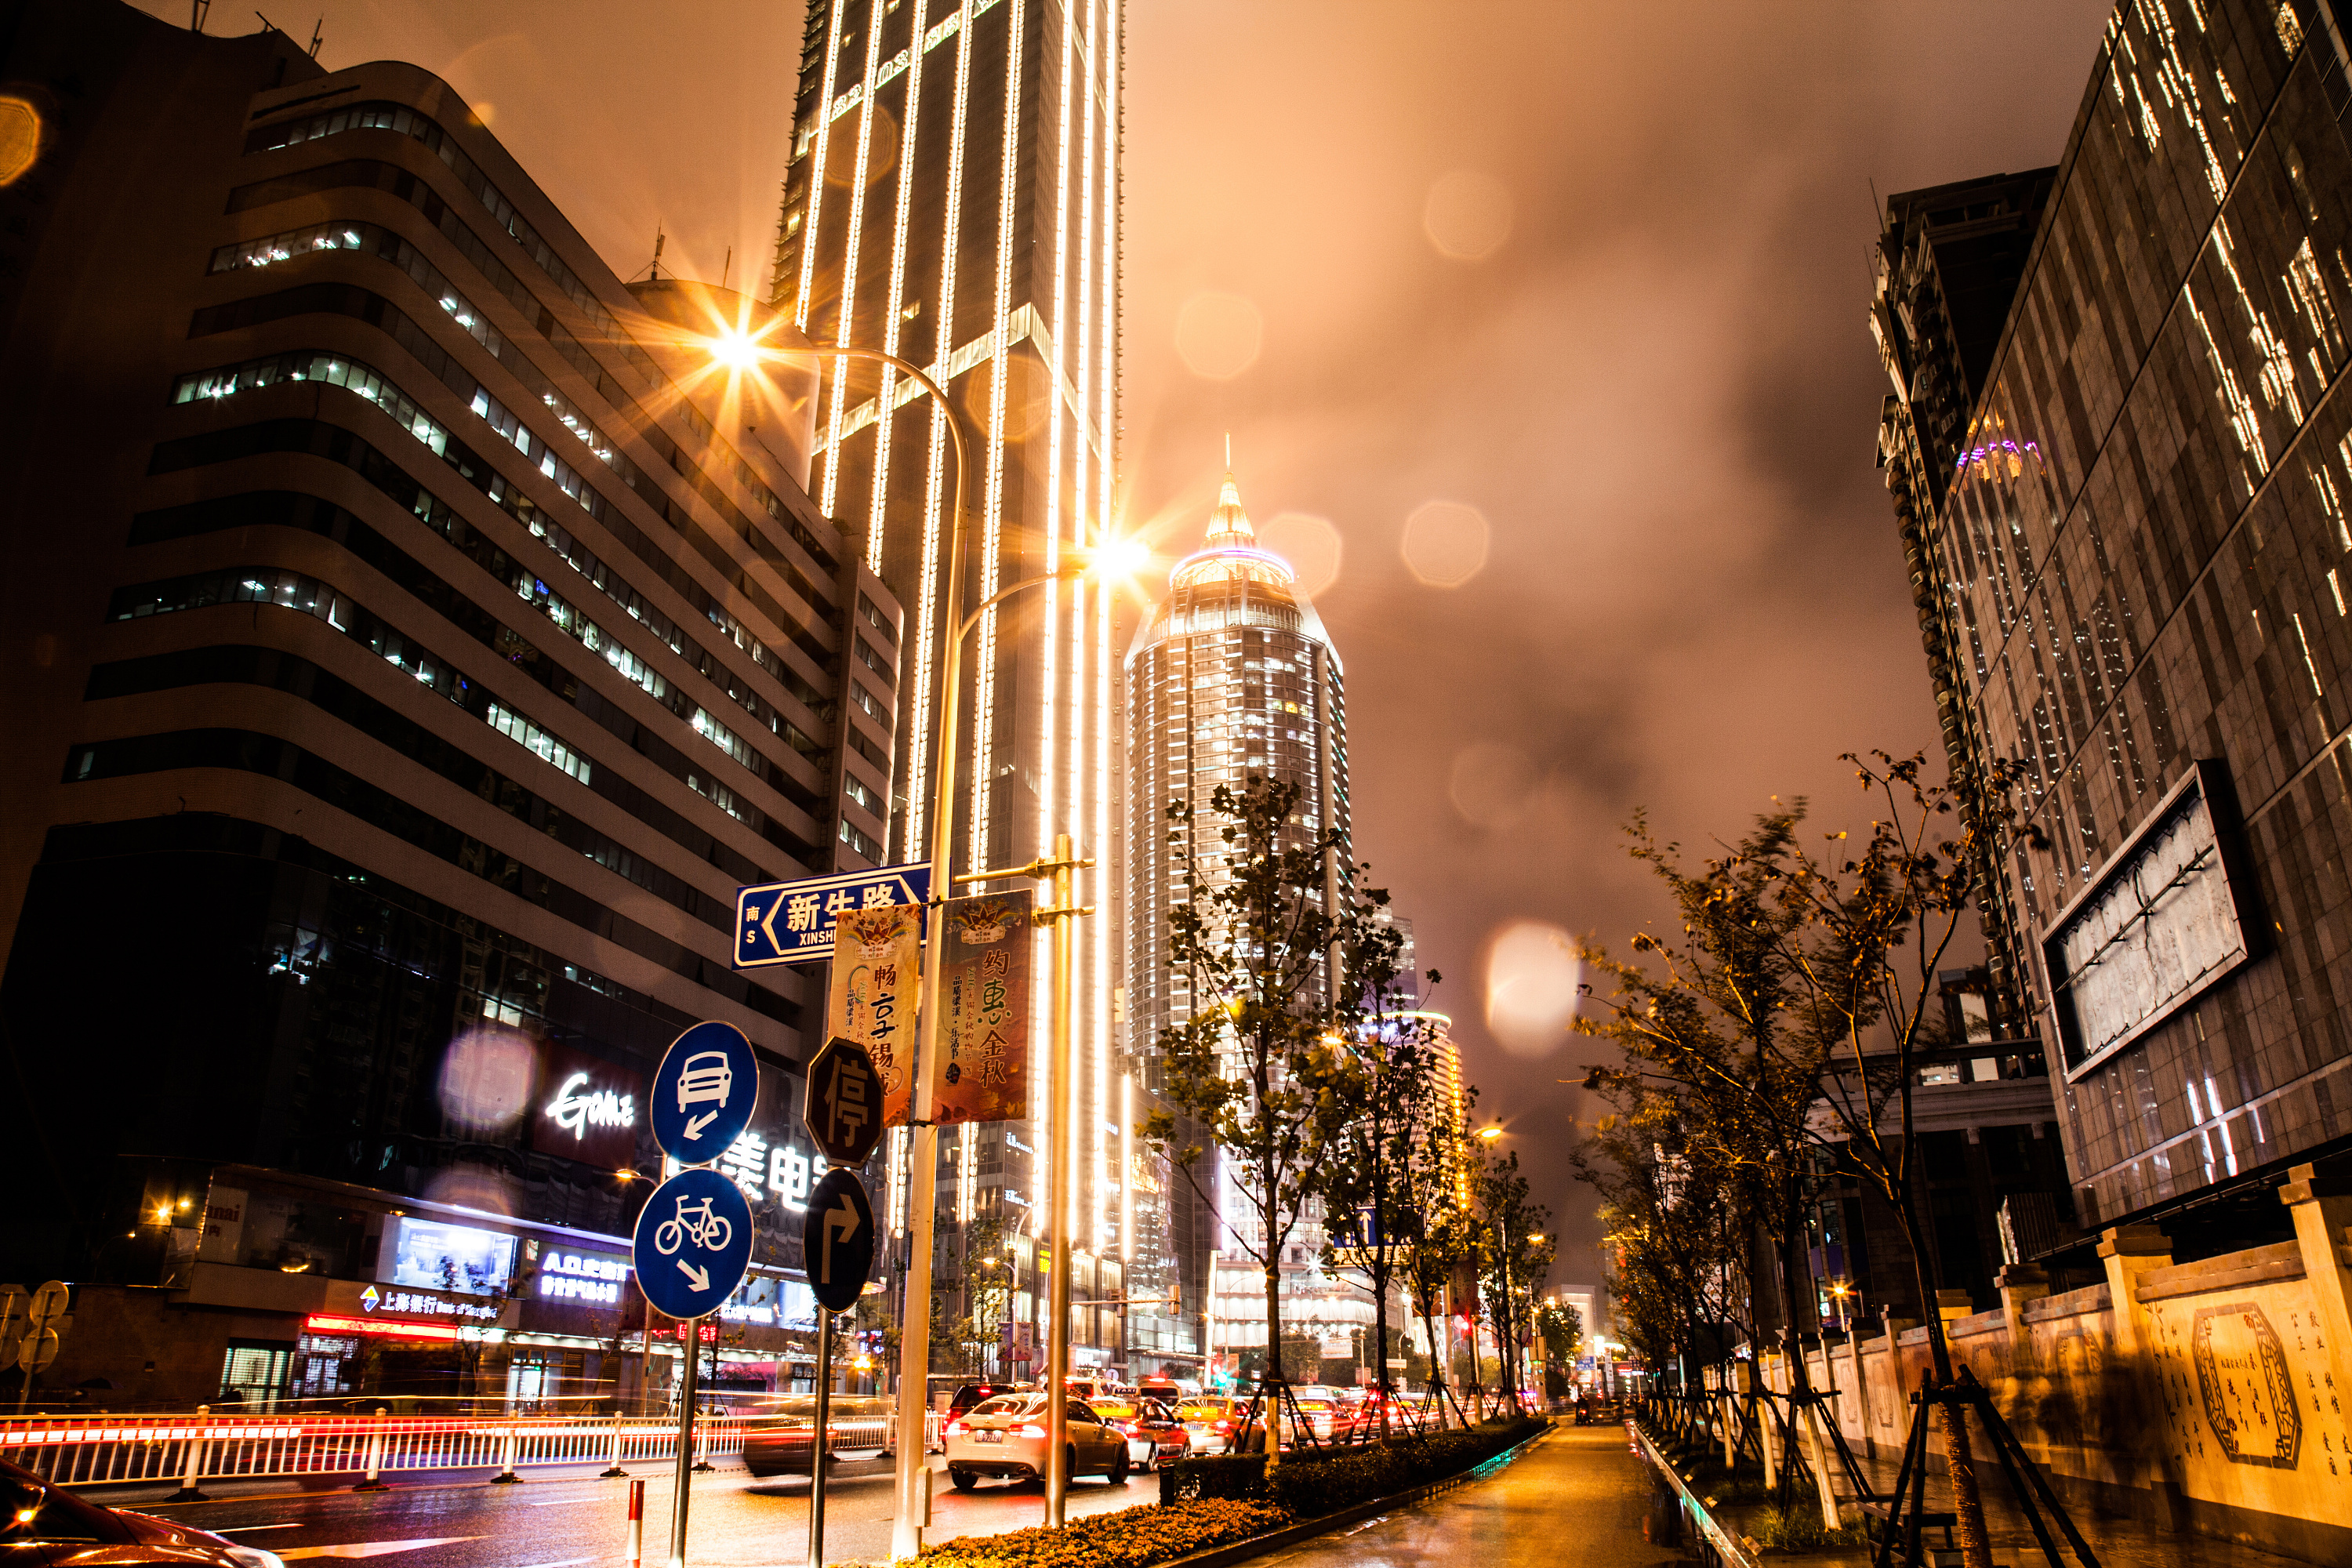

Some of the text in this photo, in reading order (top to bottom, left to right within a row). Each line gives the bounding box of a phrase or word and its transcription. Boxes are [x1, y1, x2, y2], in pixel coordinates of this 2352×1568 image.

[746, 906, 760, 922] 南
[786, 884, 896, 932] 新生路
[746, 930, 756, 944] S
[799, 929, 837, 946] XINSH
[824, 1054, 869, 1147] 停
[379, 1291, 437, 1314] 上海银行
